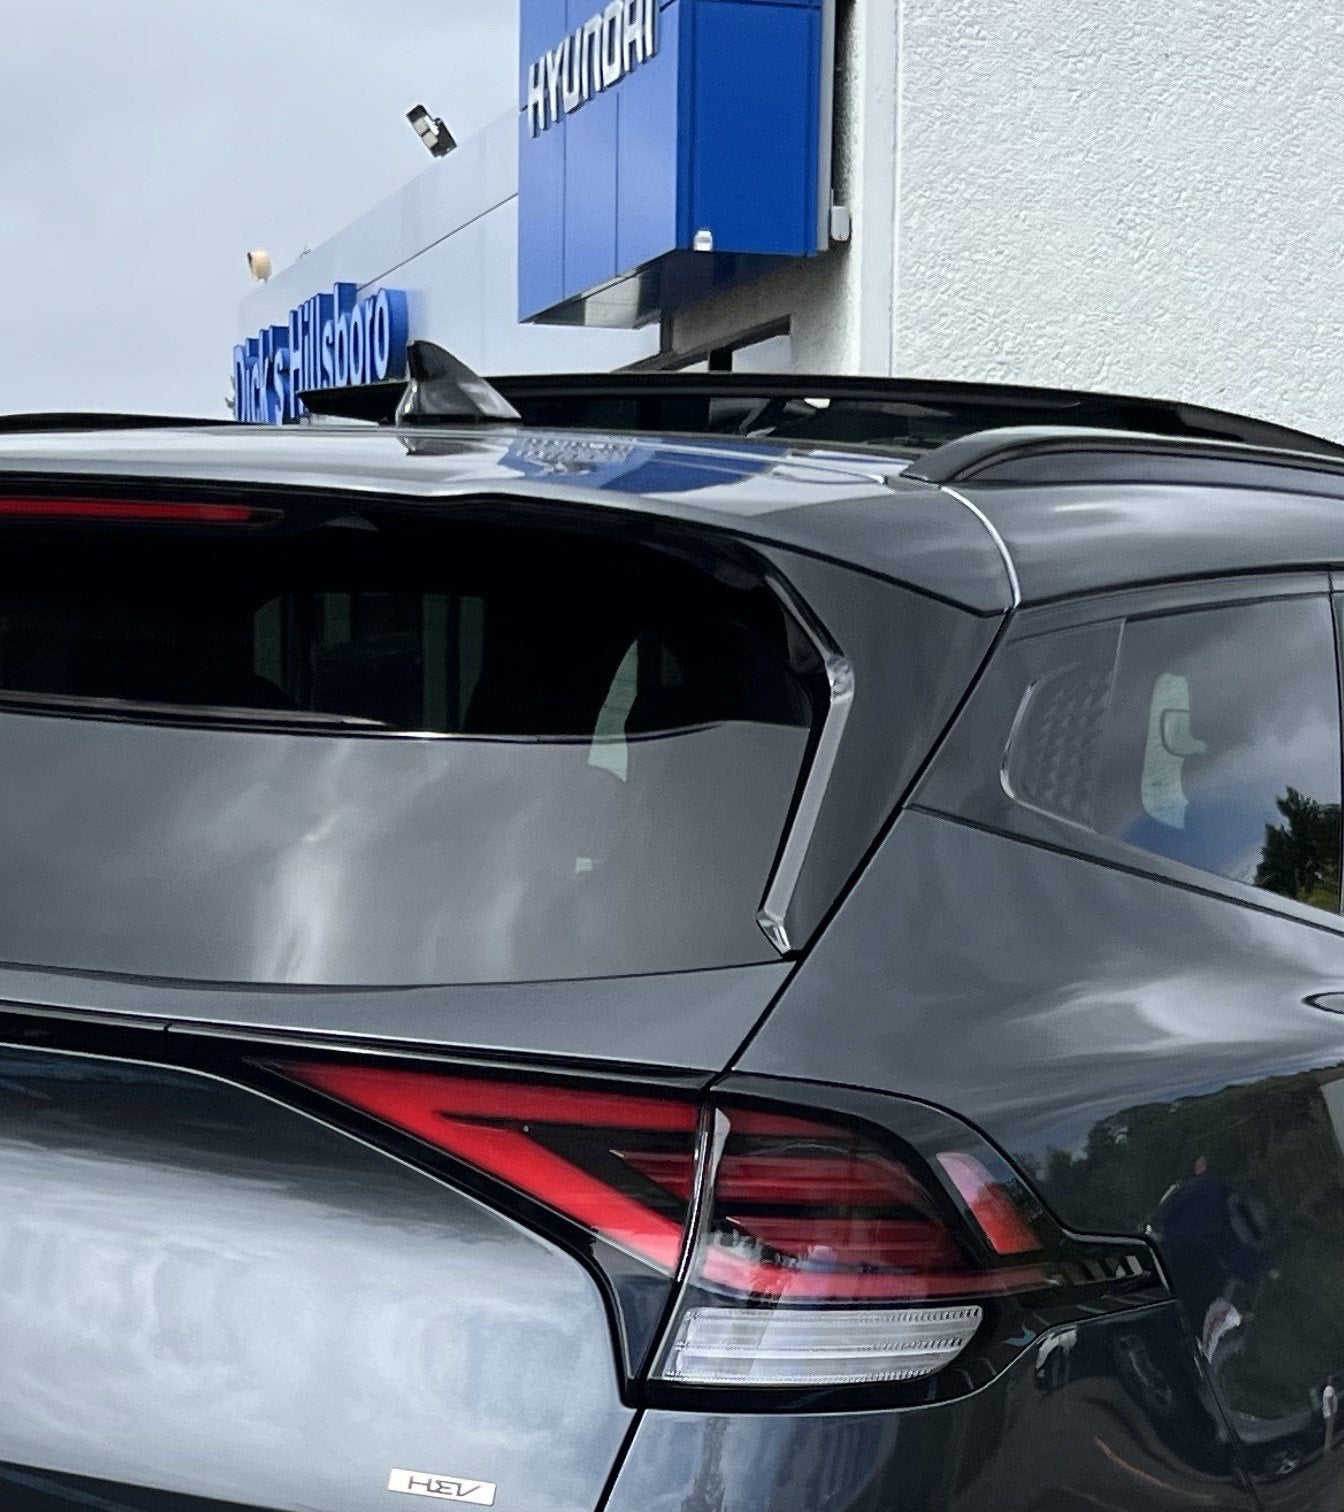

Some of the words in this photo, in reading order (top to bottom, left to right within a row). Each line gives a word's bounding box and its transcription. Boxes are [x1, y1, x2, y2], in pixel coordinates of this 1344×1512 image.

[528, 0, 655, 138] HYUNDAI
[289, 283, 396, 419] Hillsboro
[408, 1475, 481, 1497] HEV
